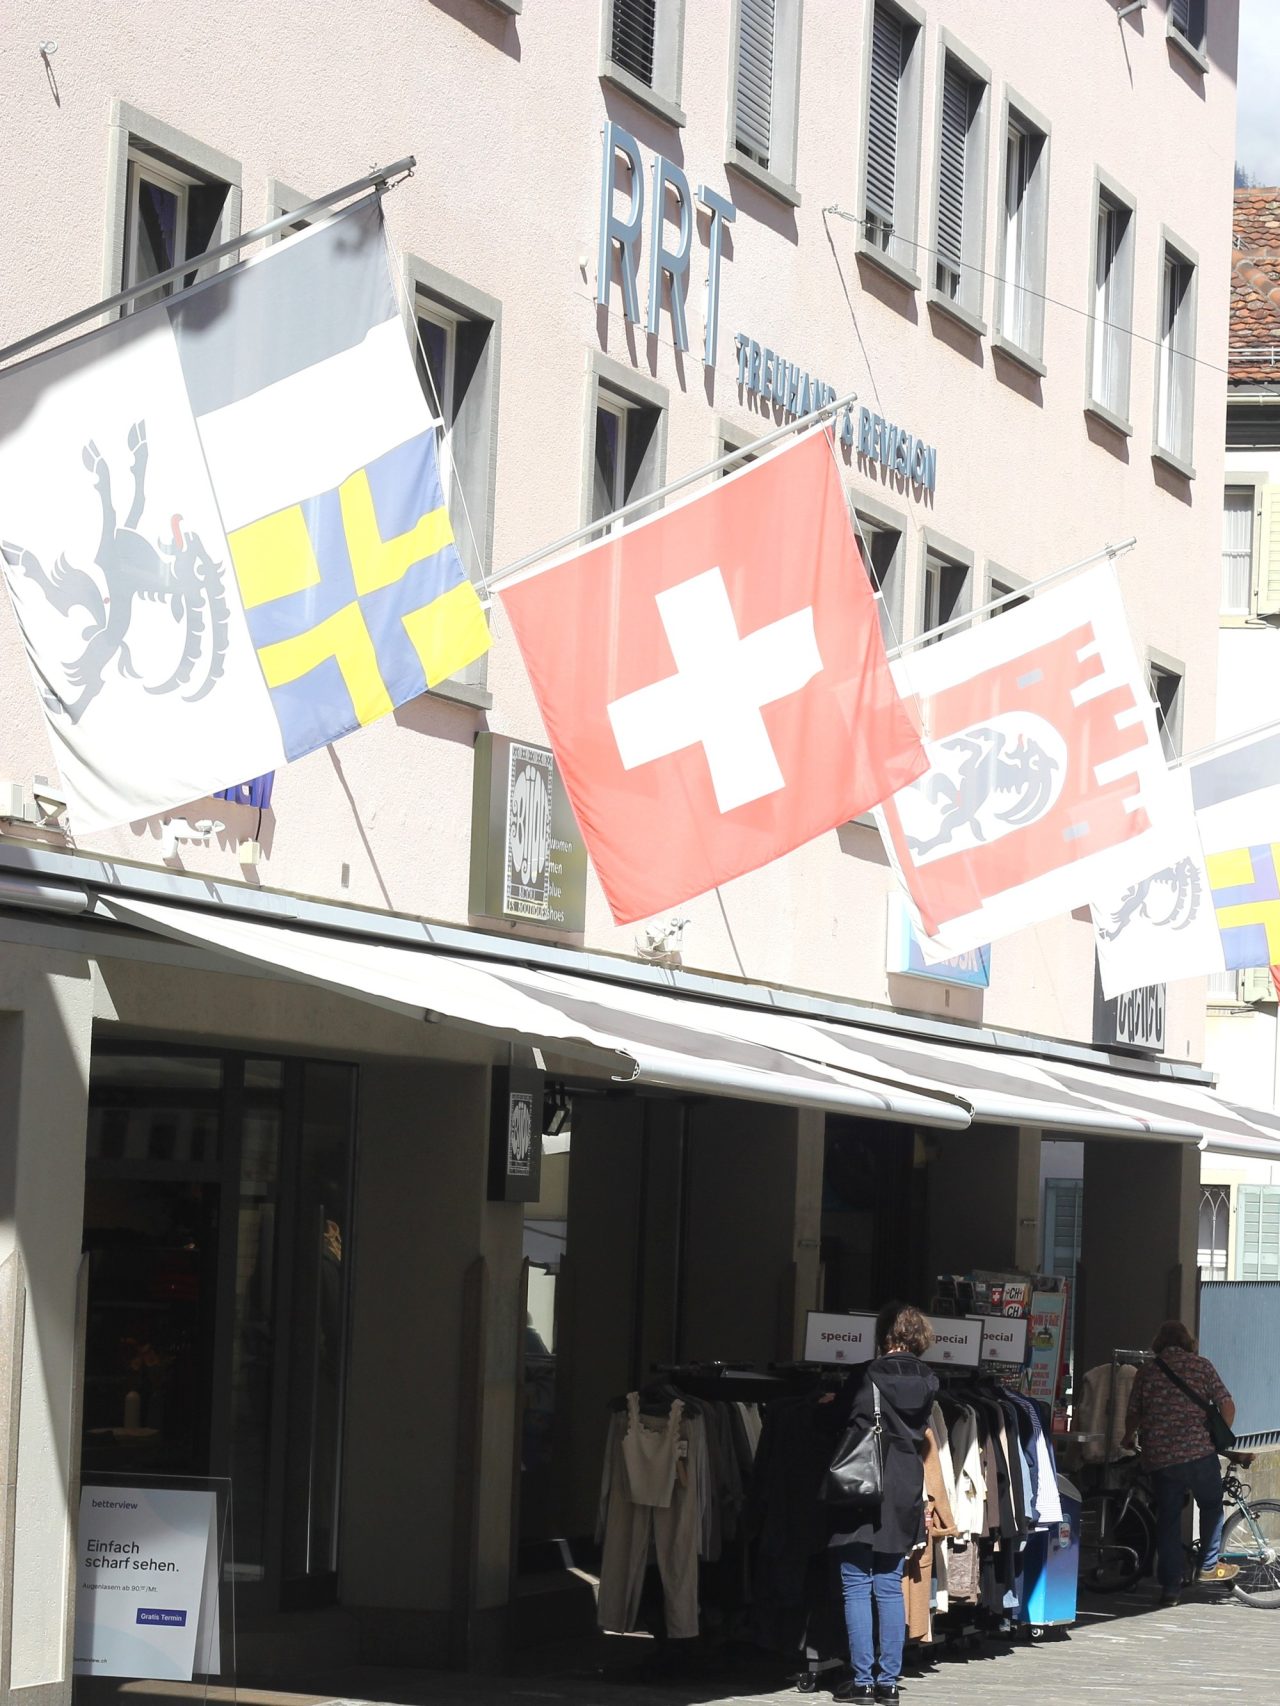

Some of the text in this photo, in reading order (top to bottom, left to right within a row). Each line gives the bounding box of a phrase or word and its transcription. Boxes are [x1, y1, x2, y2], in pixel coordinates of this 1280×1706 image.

[597, 120, 737, 367] RRT
[858, 406, 937, 492] REVISION
[820, 1332, 863, 1343] special
[983, 1332, 1014, 1342] pecial
[92, 1499, 138, 1509] betterview
[87, 1539, 140, 1554] Einfach
[85, 1556, 179, 1572] scharf sehen.
[140, 1612, 182, 1622] Gratis Termin
